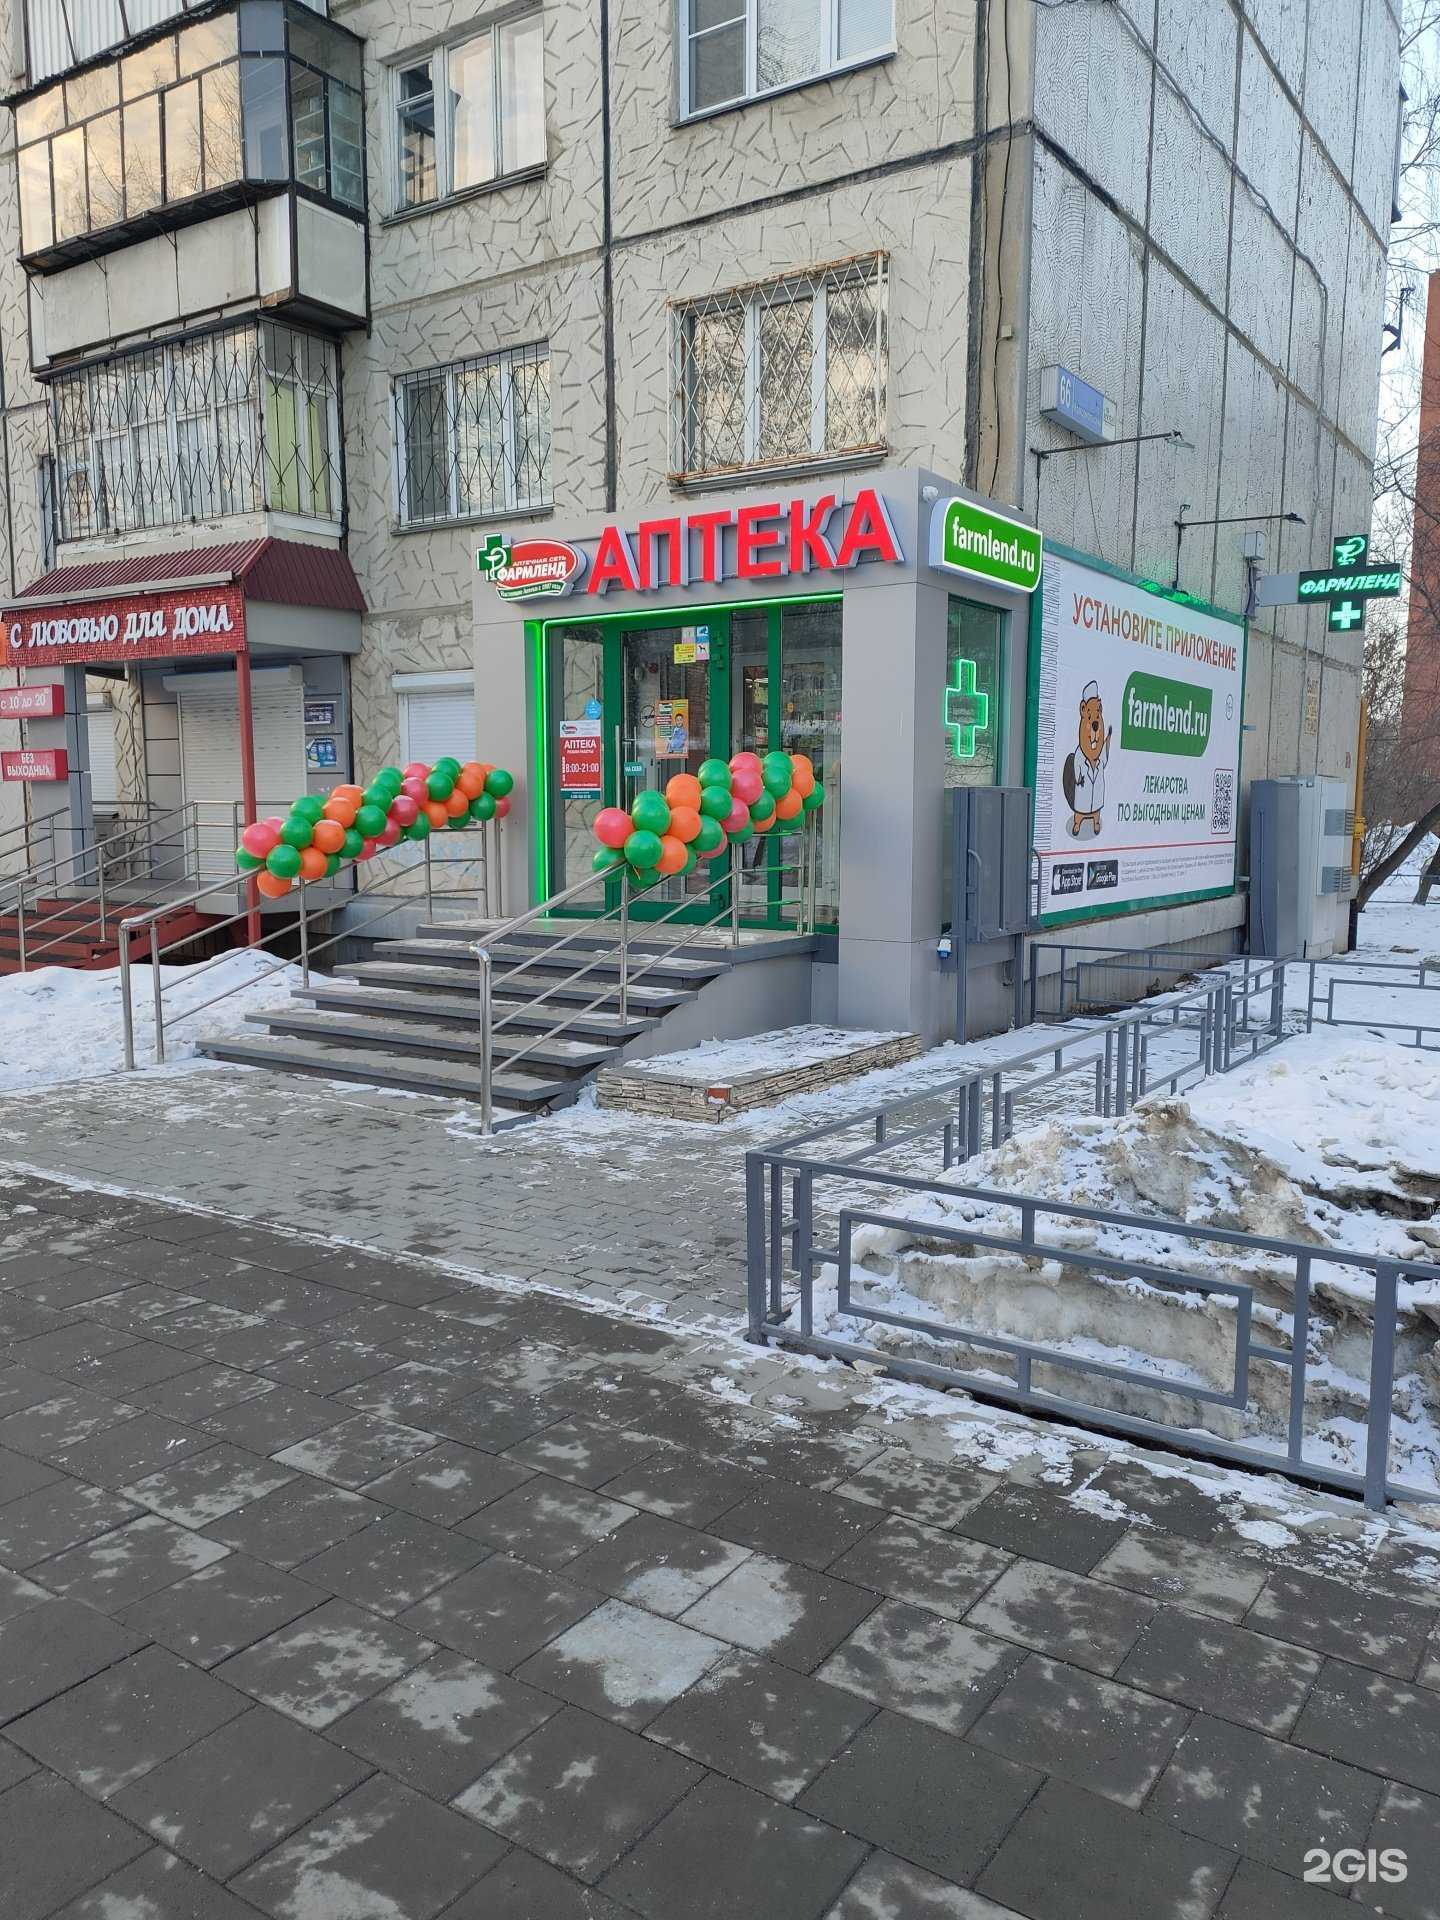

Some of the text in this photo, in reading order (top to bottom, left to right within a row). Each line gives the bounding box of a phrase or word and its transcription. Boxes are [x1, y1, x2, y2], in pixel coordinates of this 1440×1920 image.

[1060, 376, 1071, 408] 66
[588, 489, 900, 593] АПТЕКА
[952, 516, 1035, 572] farmlend.ru
[497, 561, 567, 580] ФАРМЛЕНД
[1300, 573, 1400, 594] ФАРМЛЕНД
[10, 604, 234, 648] С ЛЮБОВЬЮ ДЛЯ ДОМА
[1072, 593, 1237, 672] УСТАНОВИТЕ ПРИЛОЖЕНИЕ
[1128, 687, 1208, 737] farmlend.ru
[564, 739, 597, 749] АПТЕКА
[21, 753, 34, 764] БЕЗ
[565, 763, 599, 773] 8:00-21:00
[7, 764, 50, 777] ВЫХОДНЫХ
[1142, 775, 1188, 794] ЛЕКАРСТВА
[1118, 803, 1206, 823] ПО ВЫГОДНЫМ ЦЕНАМ
